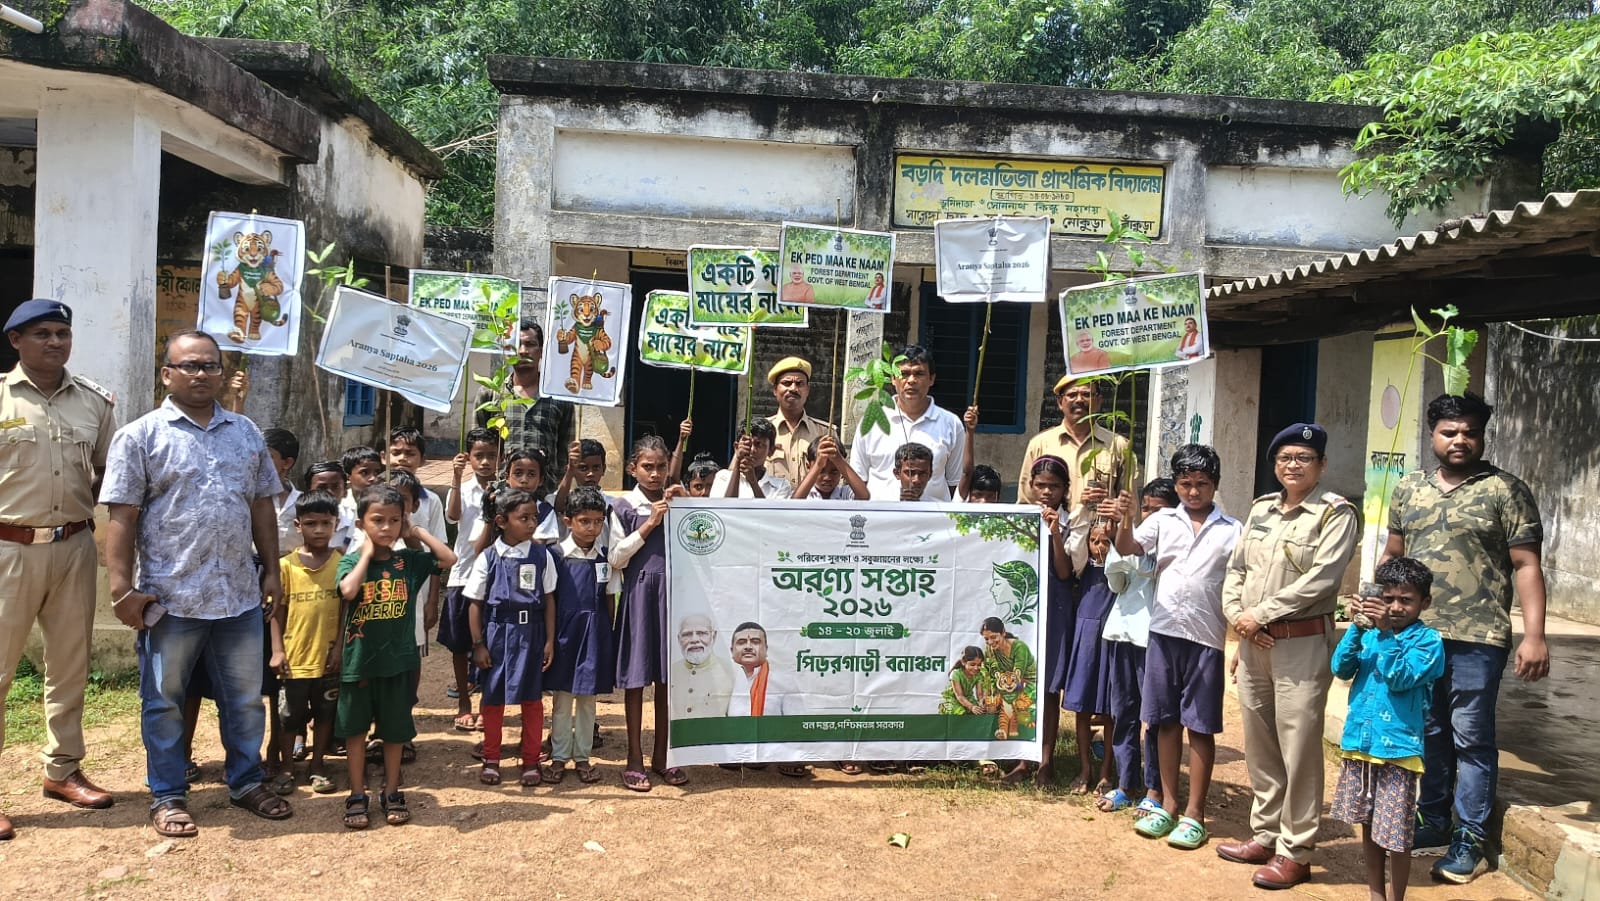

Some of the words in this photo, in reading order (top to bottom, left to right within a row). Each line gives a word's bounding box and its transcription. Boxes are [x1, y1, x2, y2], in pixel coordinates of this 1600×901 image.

[1041, 166, 1106, 191] প্রাথমিক
[1109, 167, 1162, 193] বিদ্যালয়
[701, 255, 755, 286] একটি
[791, 251, 803, 264] EK
[805, 252, 823, 265] PED
[825, 254, 844, 268] MAA
[846, 257, 857, 269] KE
[859, 258, 884, 271] NAAM
[957, 263, 982, 272] Aranya
[807, 276, 824, 284] GOVT.
[825, 277, 834, 285] OF
[834, 278, 848, 286] WEST
[849, 280, 871, 288] BENGAL
[811, 268, 833, 276] FOREST
[835, 270, 869, 280] DEPARTMENT
[420, 297, 432, 308] EK
[434, 298, 451, 309] PED
[453, 299, 470, 311] MAA
[696, 291, 752, 314] মায়ের
[1075, 316, 1089, 330] EK
[1093, 313, 1114, 327] PED
[1117, 310, 1141, 324] MAA
[1144, 307, 1159, 321] KE
[1162, 303, 1195, 318] NAAM
[1098, 338, 1119, 348] GOVT.
[1120, 337, 1131, 346] OF
[1132, 334, 1150, 344] WEST
[1152, 331, 1181, 341] BENGAL
[1101, 327, 1129, 338] FOREST
[1131, 321, 1177, 334] DEPARTMENT
[348, 339, 378, 355] Aranya
[380, 349, 415, 366] Saptaha
[416, 361, 438, 372] 2026
[647, 331, 698, 357] মায়ের
[703, 338, 743, 361] নামে
[797, 553, 826, 564] পরিবেশ
[827, 554, 851, 564] সুরক্ষা
[861, 556, 901, 565] সবুজায়নের
[903, 556, 924, 564] লক্ষ্যে
[771, 568, 855, 595] অরণ্য
[861, 567, 936, 597] সপ্তাহ
[823, 597, 892, 617] ২০২৬
[818, 626, 832, 636] ১৪
[845, 627, 861, 636] ২০
[864, 624, 895, 637] জুলাই
[796, 649, 880, 677] পিড়রগাড়ী
[885, 655, 946, 672] বনাঞ্চল
[802, 721, 815, 730] বন
[876, 721, 905, 730] সরকার
